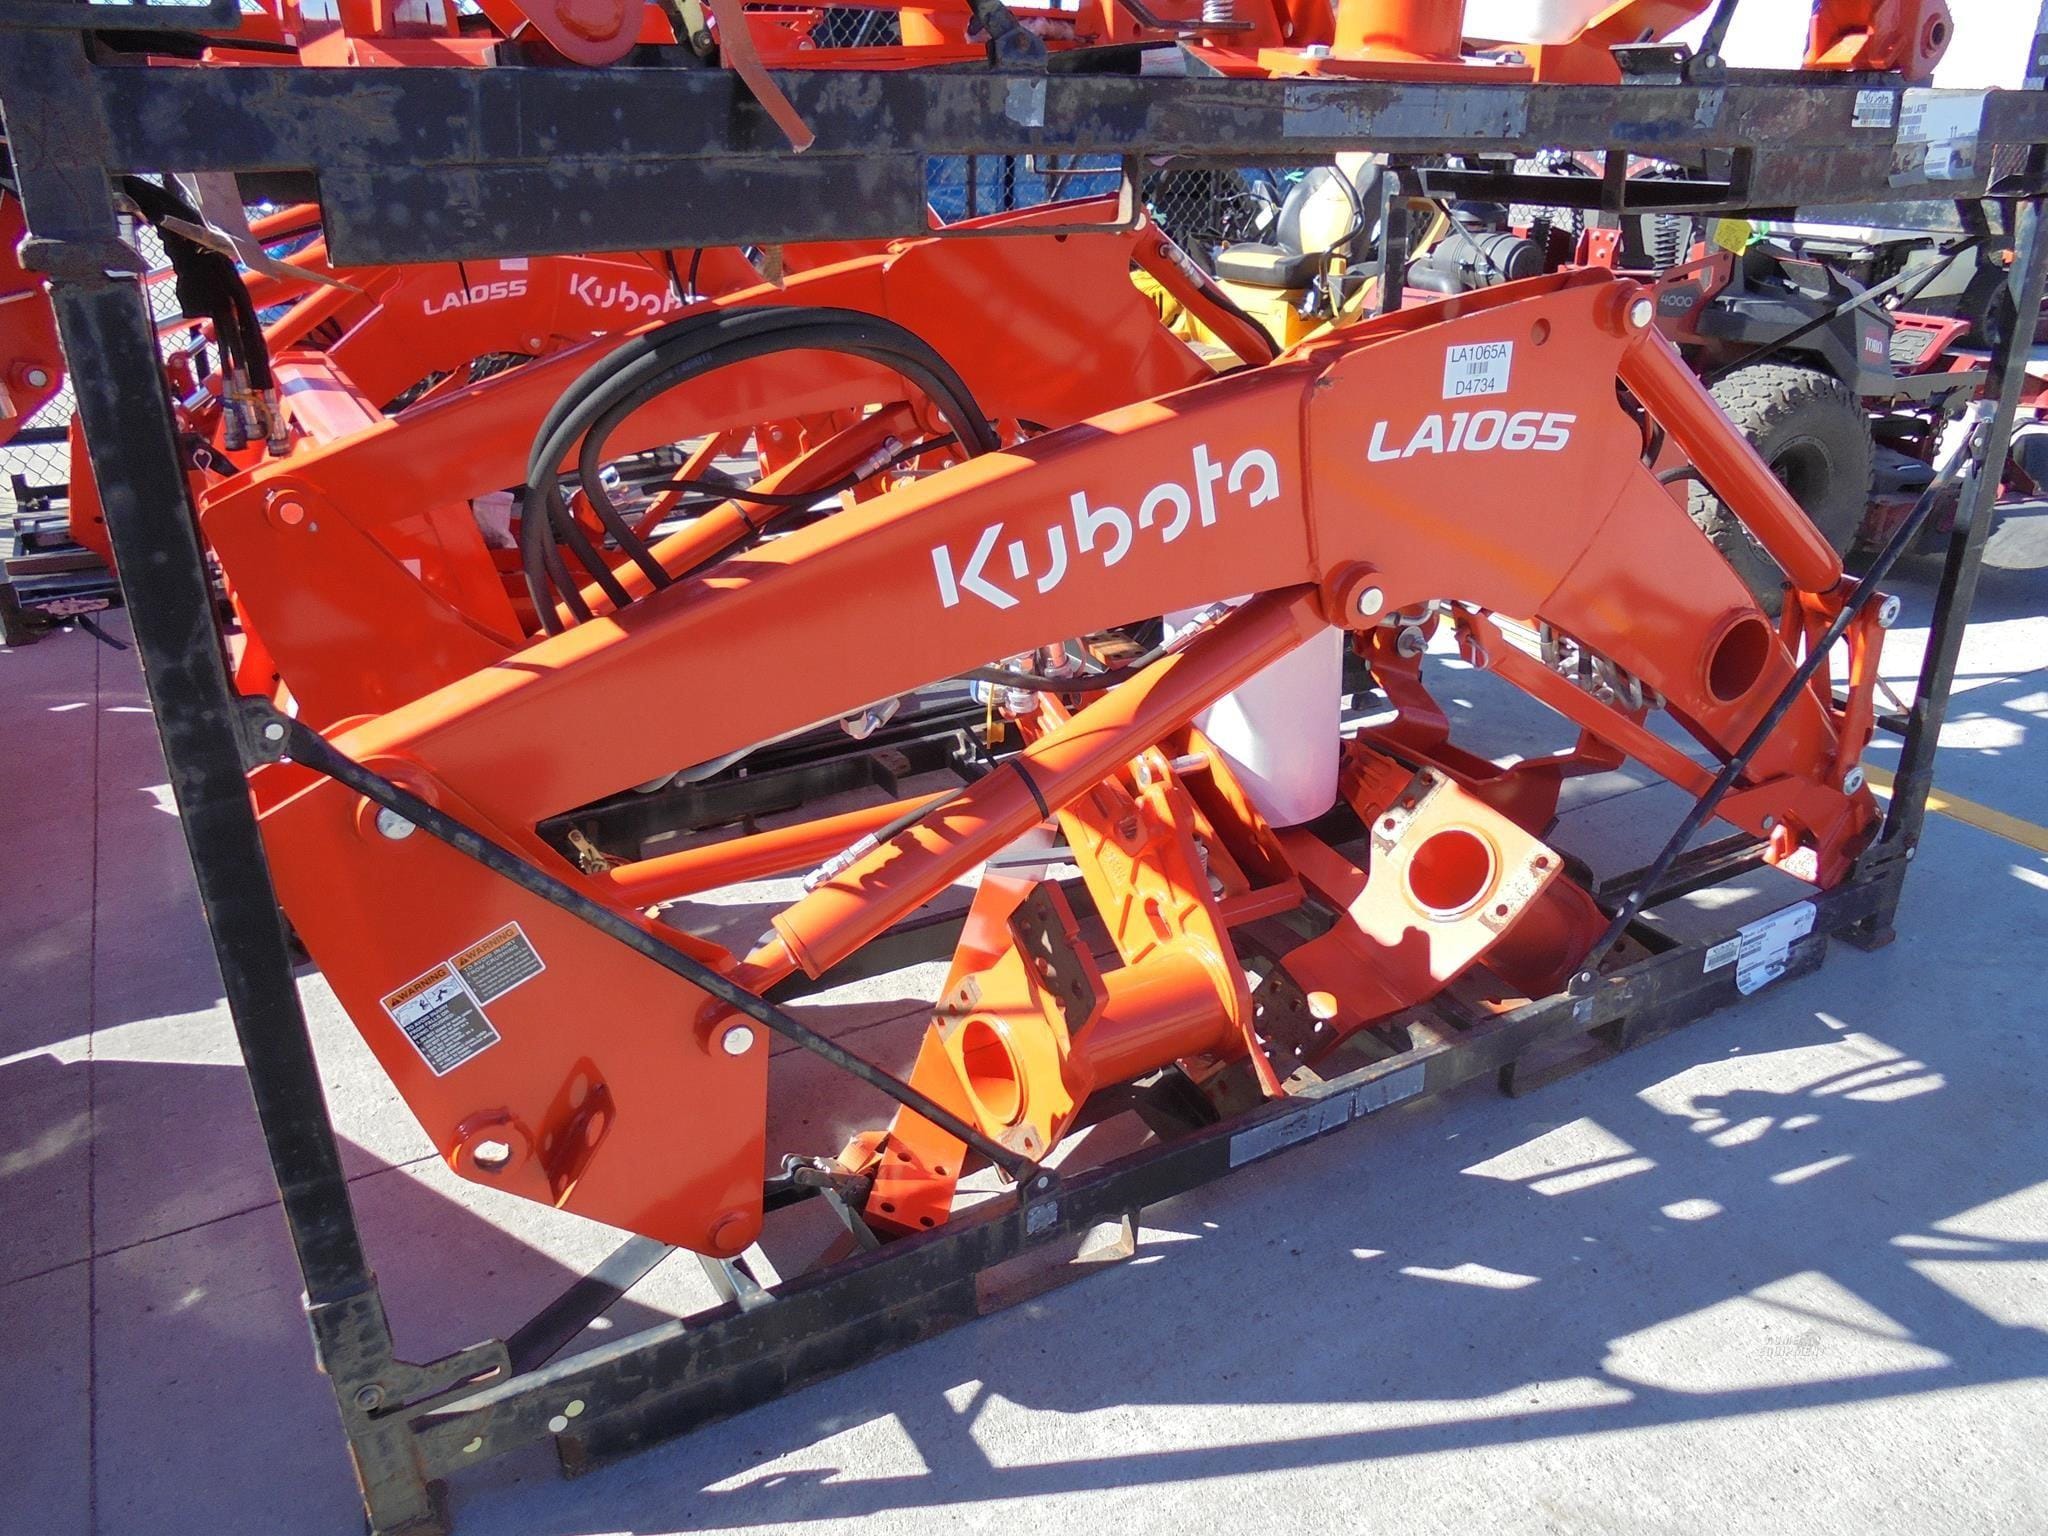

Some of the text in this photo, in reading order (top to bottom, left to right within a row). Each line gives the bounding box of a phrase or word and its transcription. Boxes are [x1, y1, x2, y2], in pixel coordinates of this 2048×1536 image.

[423, 280, 528, 316] LA1055
[1661, 295, 1693, 307] 4000
[1451, 345, 1506, 362] LA1065A
[1455, 378, 1495, 395] D4734
[1367, 410, 1577, 462] LA1065
[931, 443, 1280, 610] Kubota
[466, 928, 515, 960] WARNING
[397, 969, 447, 1000] WARNING
